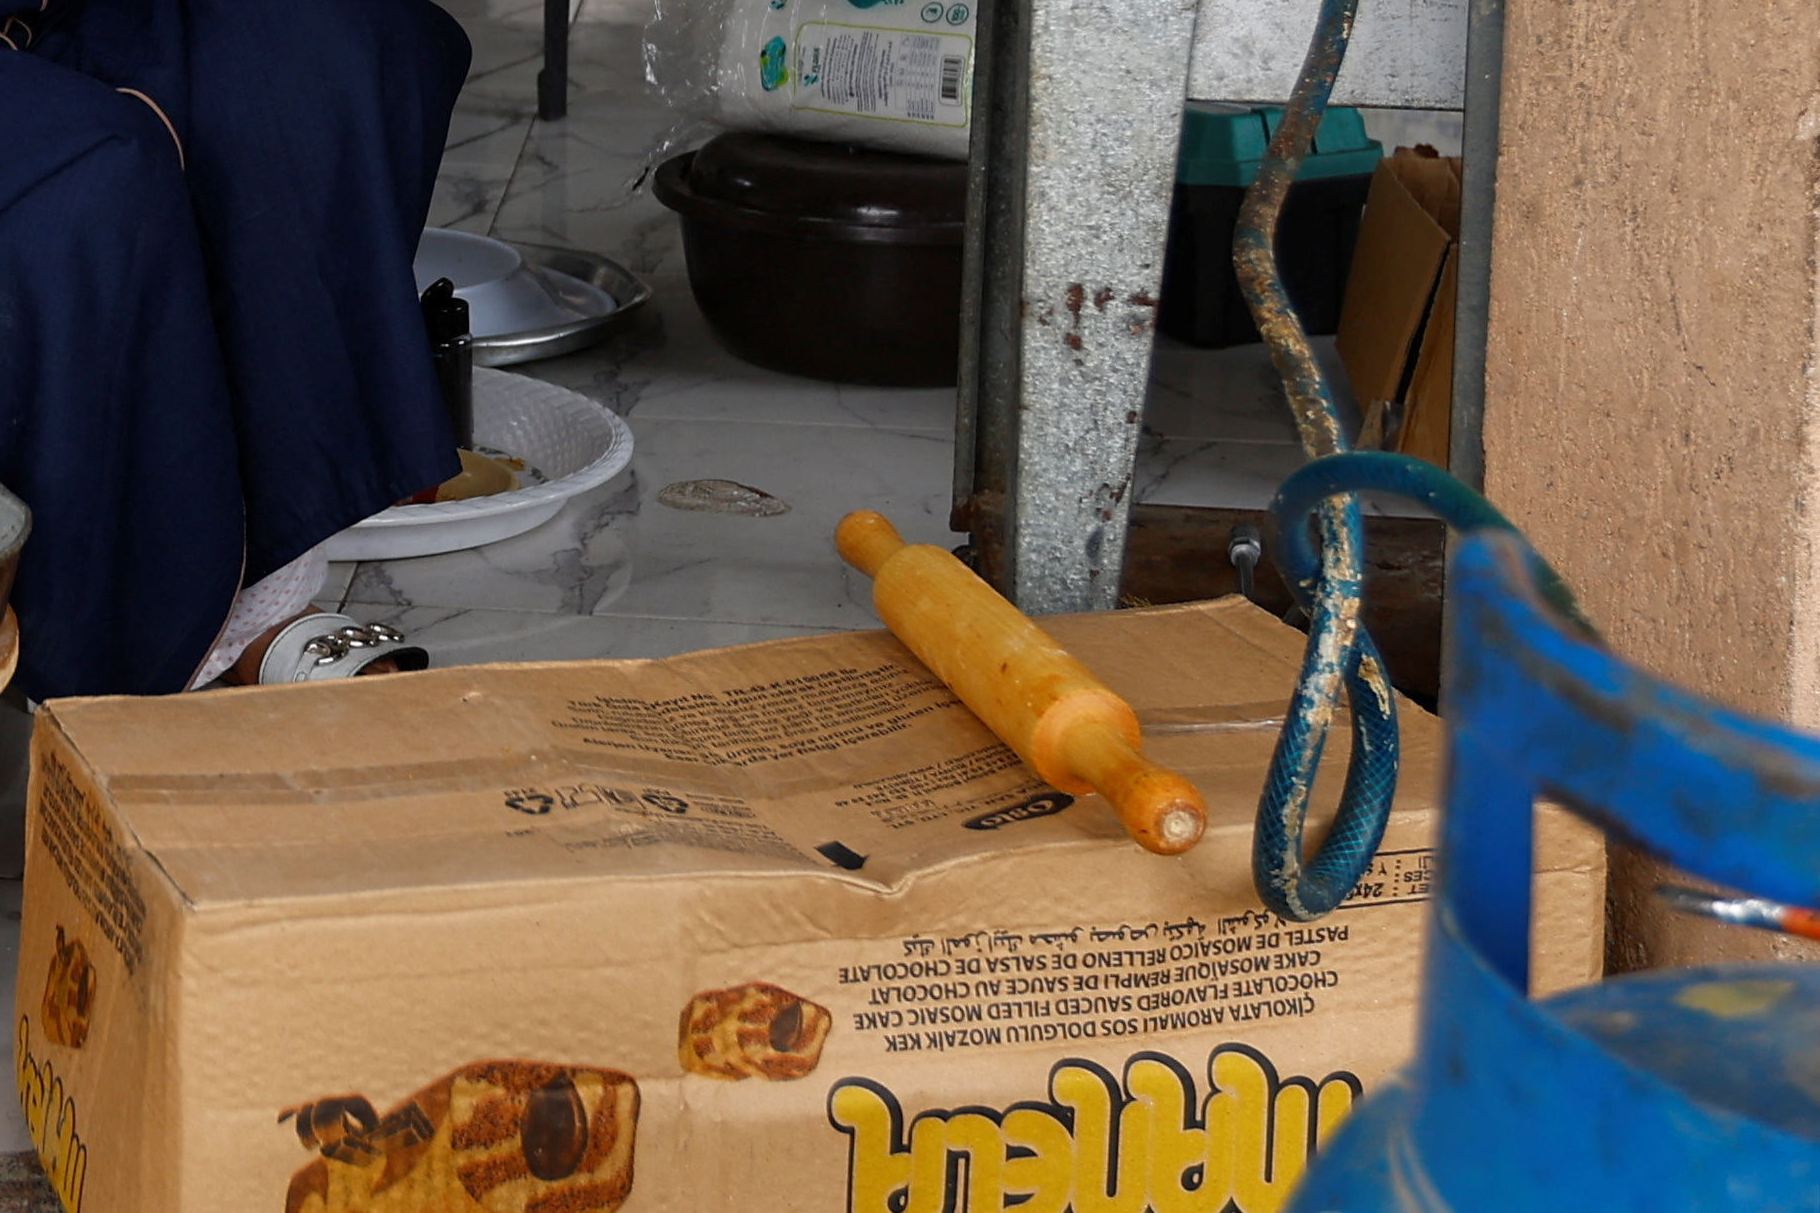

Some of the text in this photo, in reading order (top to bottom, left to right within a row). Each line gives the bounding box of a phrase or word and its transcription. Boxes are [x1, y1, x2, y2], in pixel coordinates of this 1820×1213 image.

[839, 925, 1348, 983] PASTEL DE MOSAICO RELLENO DE SALSA DE CHOCOLATE
[903, 933, 934, 956] كيك
[941, 929, 1022, 955] الموزاييك
[1029, 926, 1083, 950] محشو
[1089, 923, 1157, 944] بصوص
[853, 970, 1338, 1030] CHOCOLATE FLAVORED SAUCED FILLED MOSAIC CAKE
[868, 950, 1320, 1005] CAKE MOSAÏQUE REMPLI DE SAUCE AU CHOCOLAT
[883, 991, 1314, 1051] ÇİKOLATA AROMALI SOS DOLGULU MOZAİK KEK
